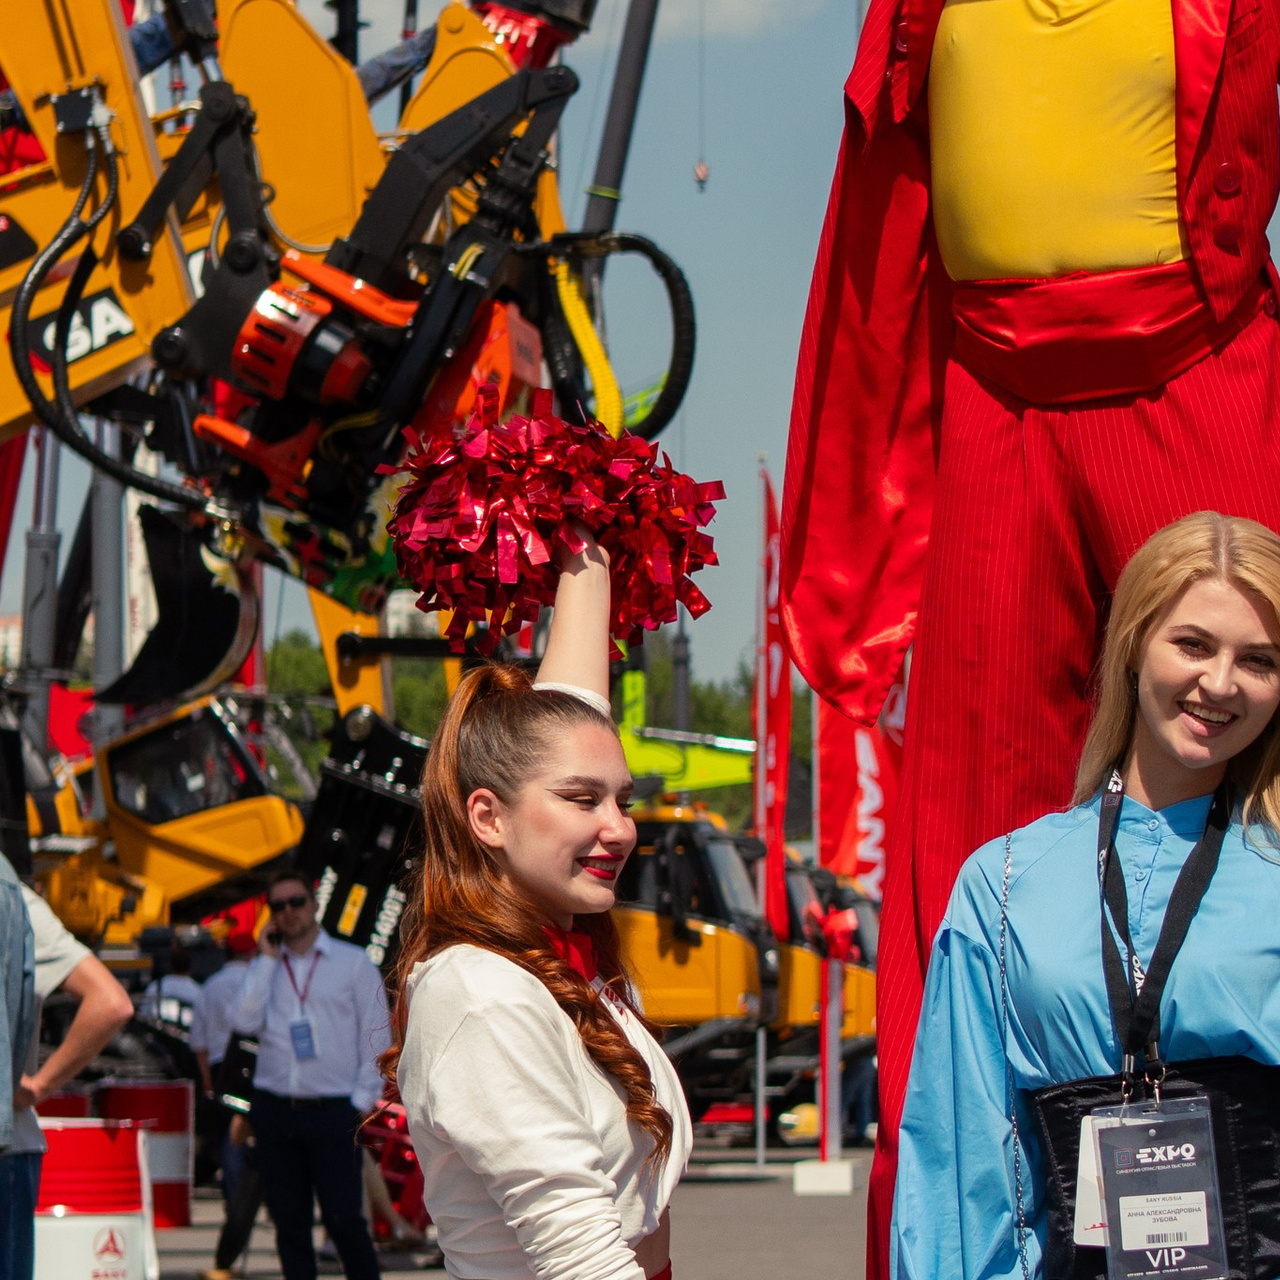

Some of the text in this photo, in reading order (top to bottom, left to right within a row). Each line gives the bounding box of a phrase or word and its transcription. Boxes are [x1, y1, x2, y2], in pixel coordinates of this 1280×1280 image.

[1136, 1143, 1195, 1163] EXPO
[1146, 1207, 1202, 1216] АЛЕКСАНДРОВНА
[1145, 1247, 1186, 1268] VIP
